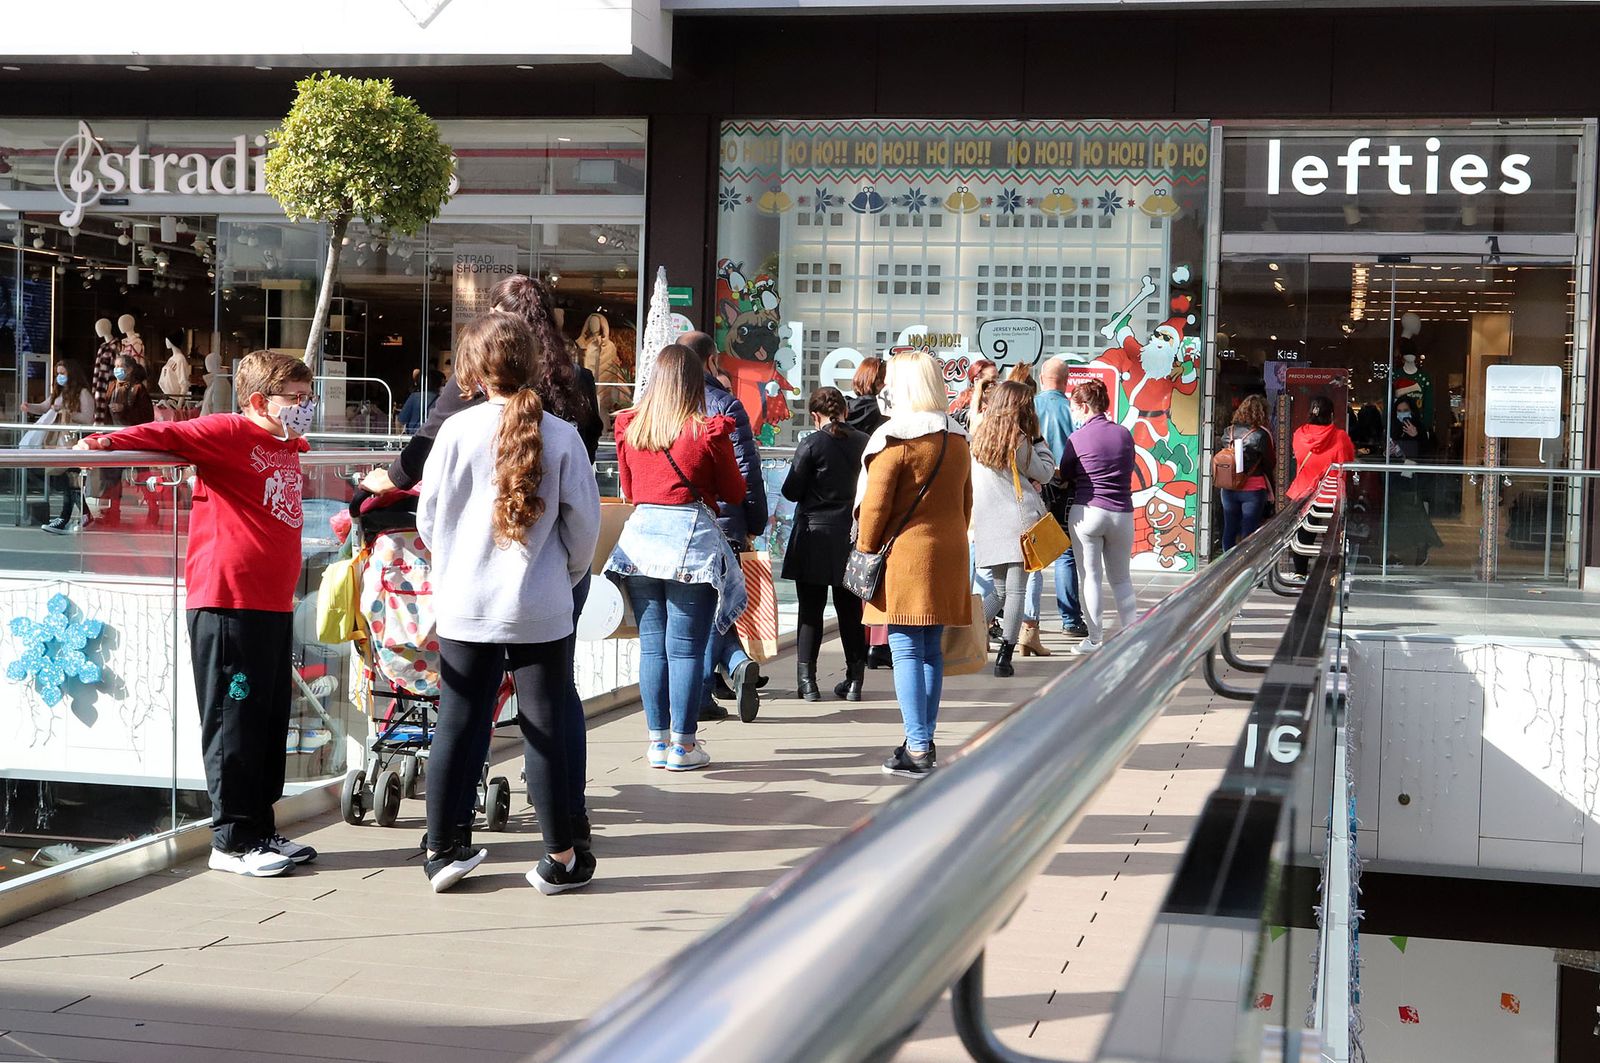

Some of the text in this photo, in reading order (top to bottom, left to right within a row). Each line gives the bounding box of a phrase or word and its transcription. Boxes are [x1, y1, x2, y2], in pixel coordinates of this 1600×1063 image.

[812, 140, 848, 165] HO!!
[854, 140, 878, 165] HO
[882, 140, 920, 166] HO!!
[926, 140, 949, 166] HO
[954, 140, 992, 166] HO!!
[1007, 141, 1031, 166] HO
[1035, 141, 1073, 167] HO!!
[1080, 141, 1103, 167] HO
[1107, 142, 1146, 168] HO!!
[1153, 142, 1179, 168] HO
[1182, 142, 1208, 168] HO
[1267, 136, 1533, 196] lefties
[456, 254, 495, 264] STRADI
[456, 264, 514, 274] SHOPPERS
[908, 333, 962, 348] HO HO HO!!
[993, 339, 1008, 360] 9
[1277, 349, 1298, 360] Kids
